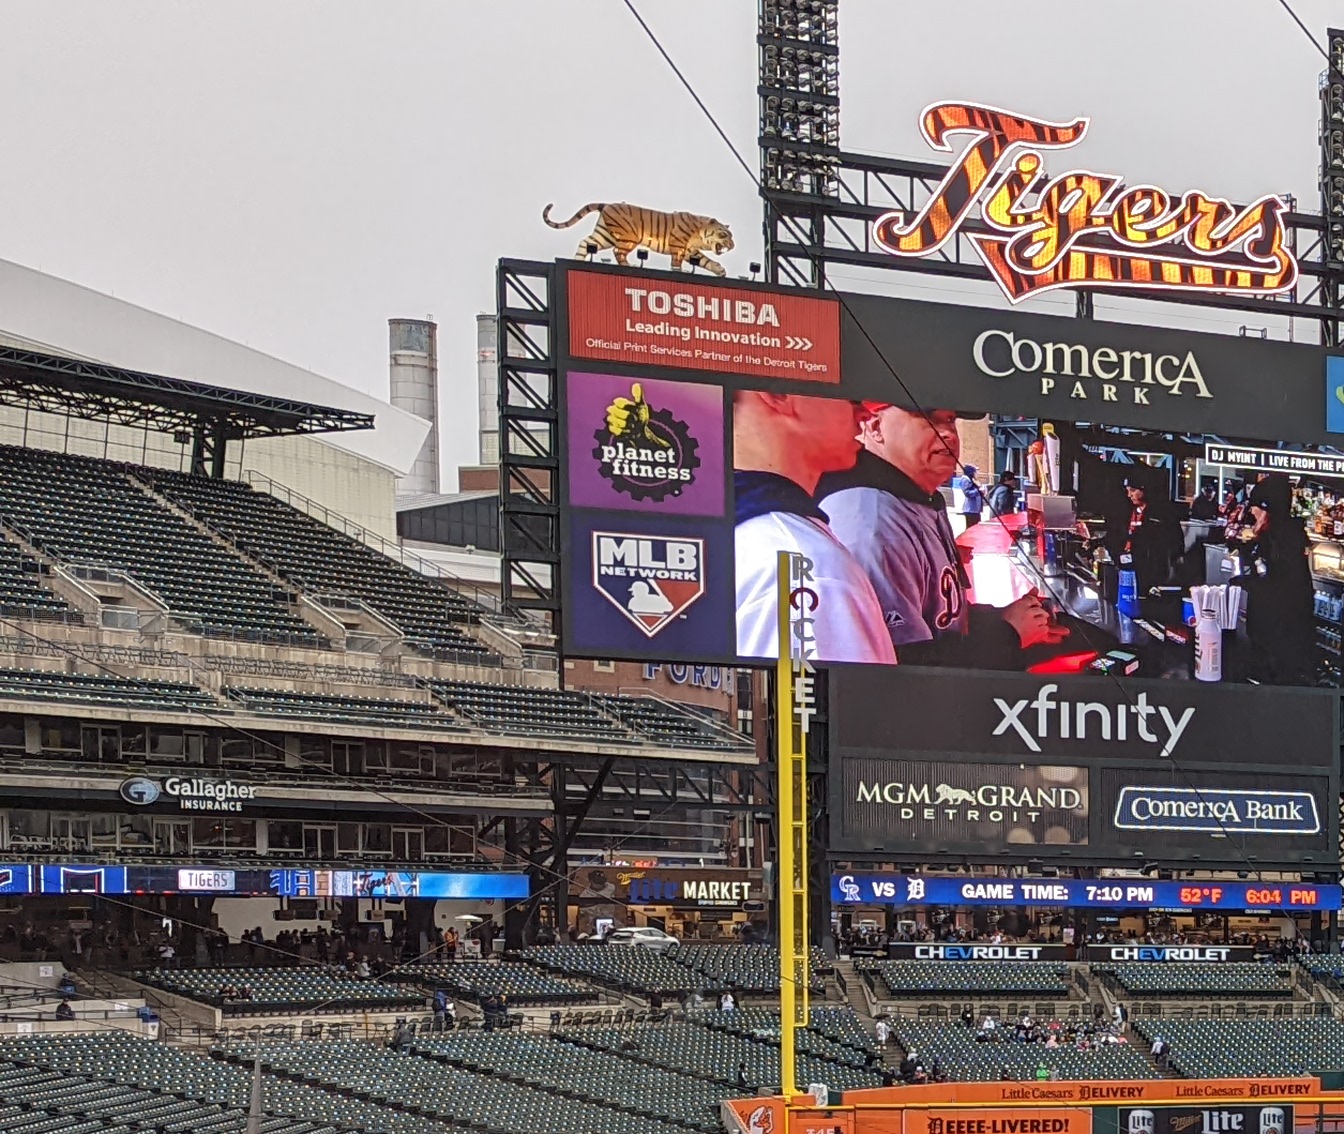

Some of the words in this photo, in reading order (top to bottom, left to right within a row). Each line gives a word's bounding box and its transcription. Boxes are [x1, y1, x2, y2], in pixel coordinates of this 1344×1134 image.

[873, 100, 1298, 305] Tigers
[625, 288, 780, 328] TOSHIBA
[626, 319, 691, 341] Leading
[695, 328, 781, 348] Innovation
[624, 342, 647, 353] Print
[651, 345, 693, 357] Services
[695, 350, 731, 362] Partner
[733, 354, 742, 363] of
[745, 355, 761, 365] the
[799, 360, 828, 372] Tigers
[1041, 378, 1151, 405] PARK
[601, 444, 676, 465] planet
[1211, 450, 1224, 460] DJ
[1269, 454, 1289, 467] LIVE
[1290, 456, 1316, 469] FROM
[1317, 459, 1334, 471] THE
[612, 459, 691, 481] fitness
[600, 537, 697, 570] MLB
[600, 566, 697, 581] NETWORK
[992, 684, 1196, 756] xfinity
[165, 777, 256, 800] Gallagher
[857, 781, 934, 803] MGM
[977, 784, 1080, 809] GRAND
[180, 800, 243, 811] INSURANCE
[900, 808, 1041, 823] DETROIT
[1245, 800, 1304, 820] Bank
[187, 872, 229, 888] TIGERS
[683, 881, 751, 900] MARKET
[872, 882, 895, 897] VS
[962, 884, 1014, 899] GAME
[1021, 884, 1069, 900] TIME:
[1086, 886, 1122, 901] 7:10
[1127, 887, 1153, 901] PM
[1245, 889, 1281, 904] 6:04
[1290, 890, 1316, 904] PM
[915, 946, 1042, 959] CHEVROLET
[1111, 948, 1230, 961] CHEVROLET
[1002, 1087, 1030, 1100] Little
[1031, 1087, 1074, 1100] Caesars
[1176, 1086, 1203, 1097] Little
[1205, 1086, 1244, 1097] Caesars
[1132, 1115, 1153, 1130] Lite
[1263, 1113, 1284, 1127] Lite
